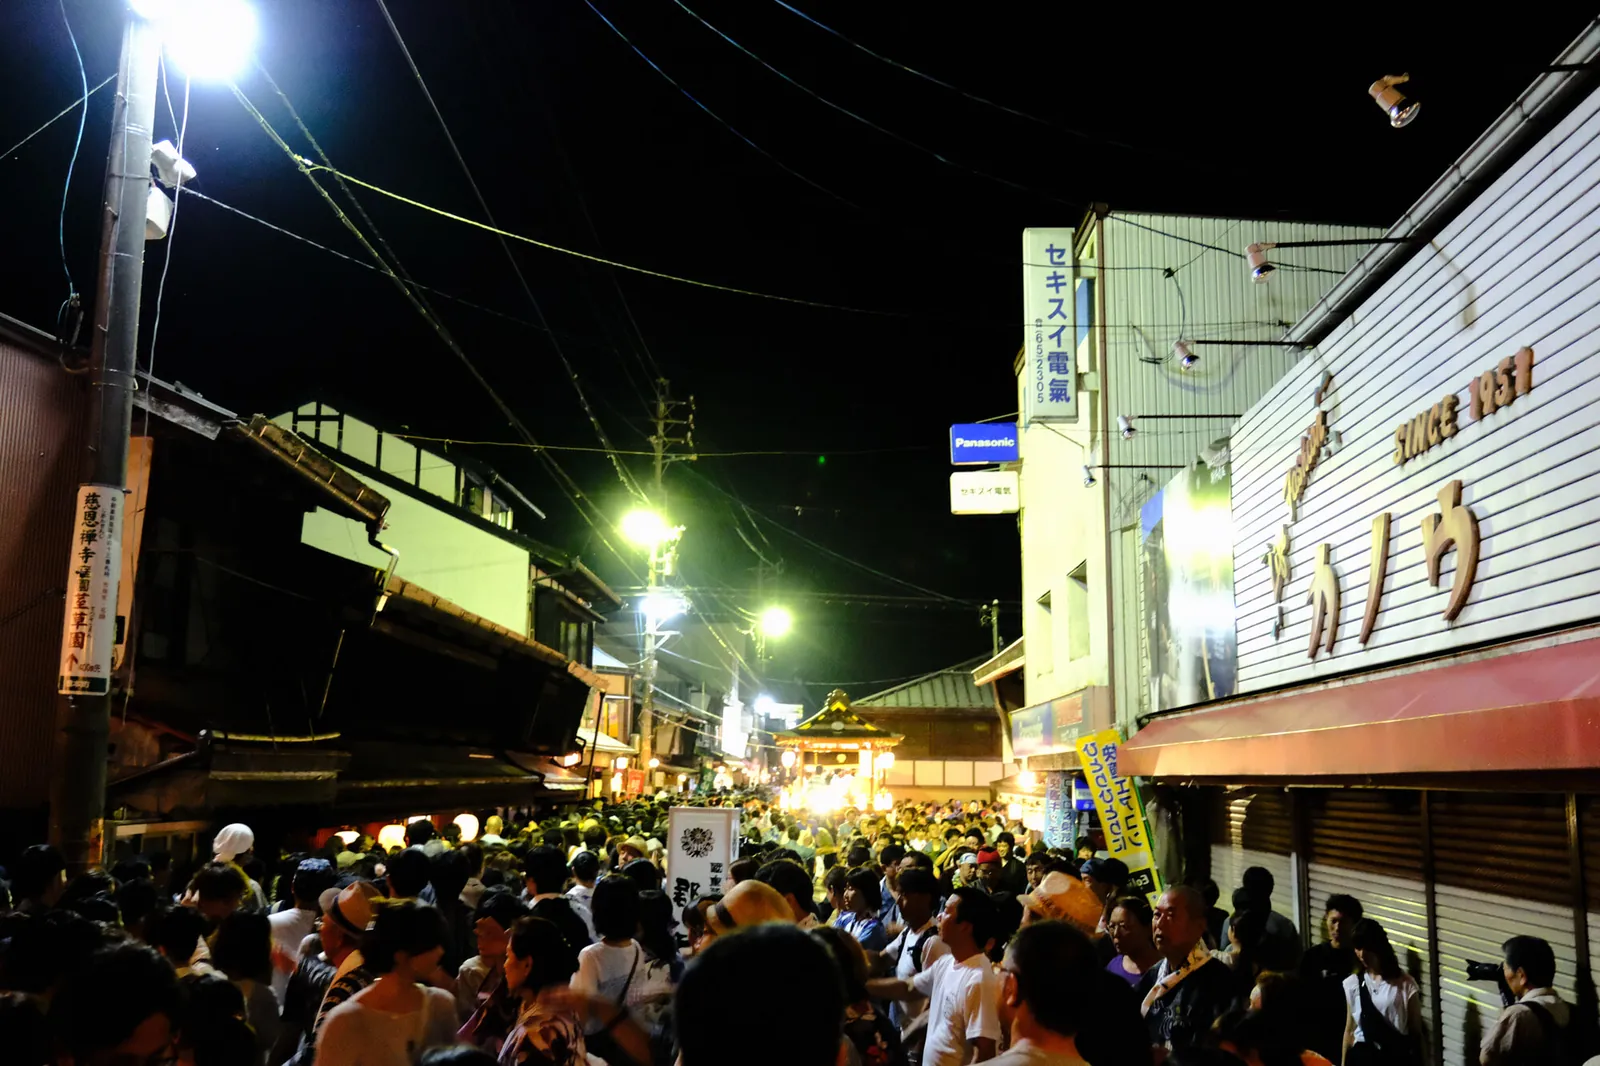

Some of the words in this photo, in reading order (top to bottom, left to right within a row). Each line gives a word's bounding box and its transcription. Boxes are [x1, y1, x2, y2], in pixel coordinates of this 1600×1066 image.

[1045, 243, 1071, 404] セキスイ電氣
[955, 436, 1016, 449] Panasonic
[1393, 393, 1460, 466] SINCE
[1468, 345, 1535, 421] 1951
[1306, 479, 1482, 660] カノウ
